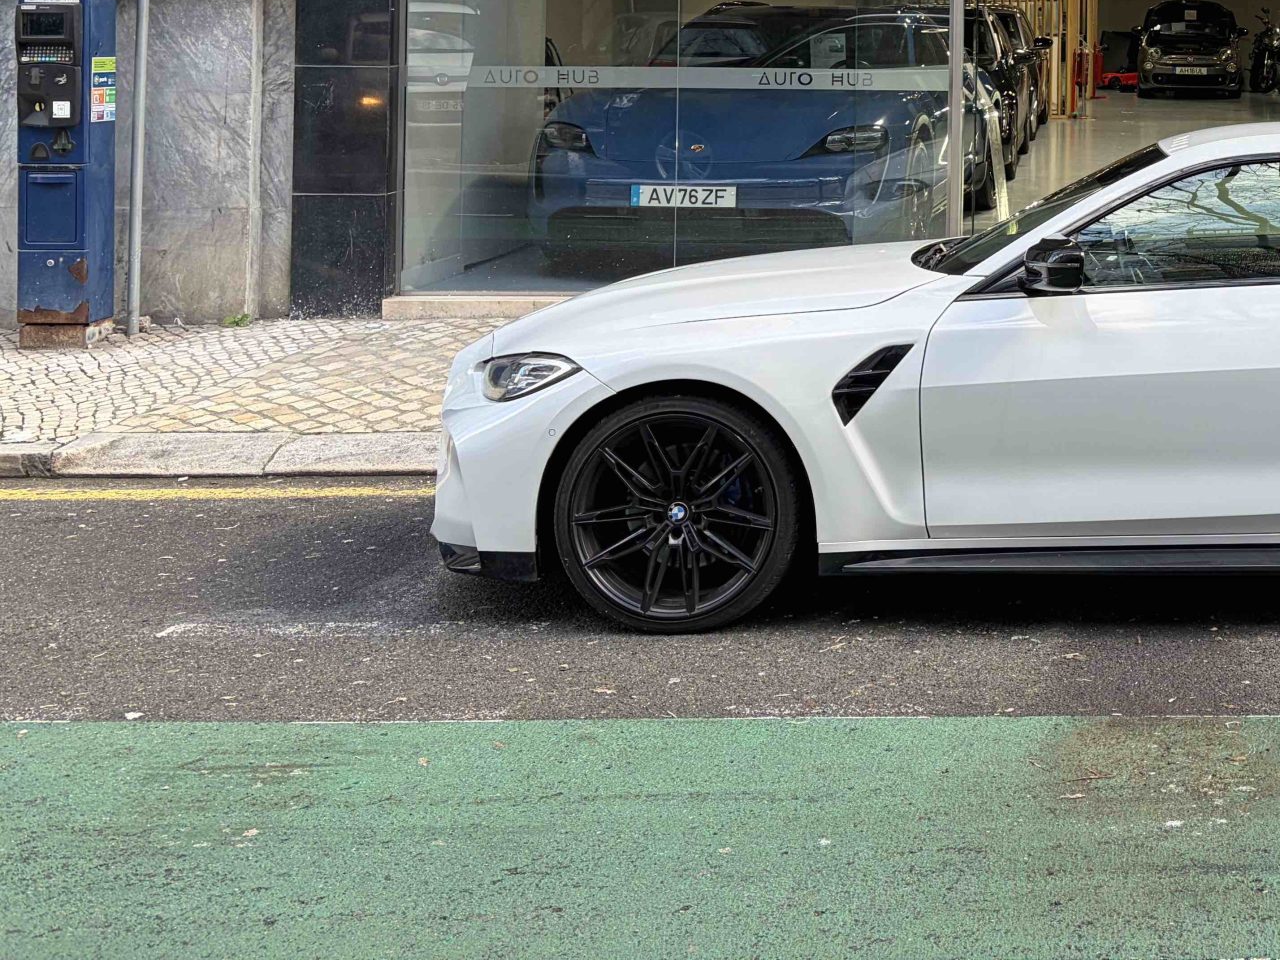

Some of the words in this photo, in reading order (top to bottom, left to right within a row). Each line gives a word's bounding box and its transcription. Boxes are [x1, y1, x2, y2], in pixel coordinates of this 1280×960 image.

[484, 69, 539, 84] AUTO
[557, 69, 600, 84] HUB
[758, 71, 813, 86] AUTO
[831, 72, 873, 87] HUB
[648, 187, 727, 205] AV76ZF
